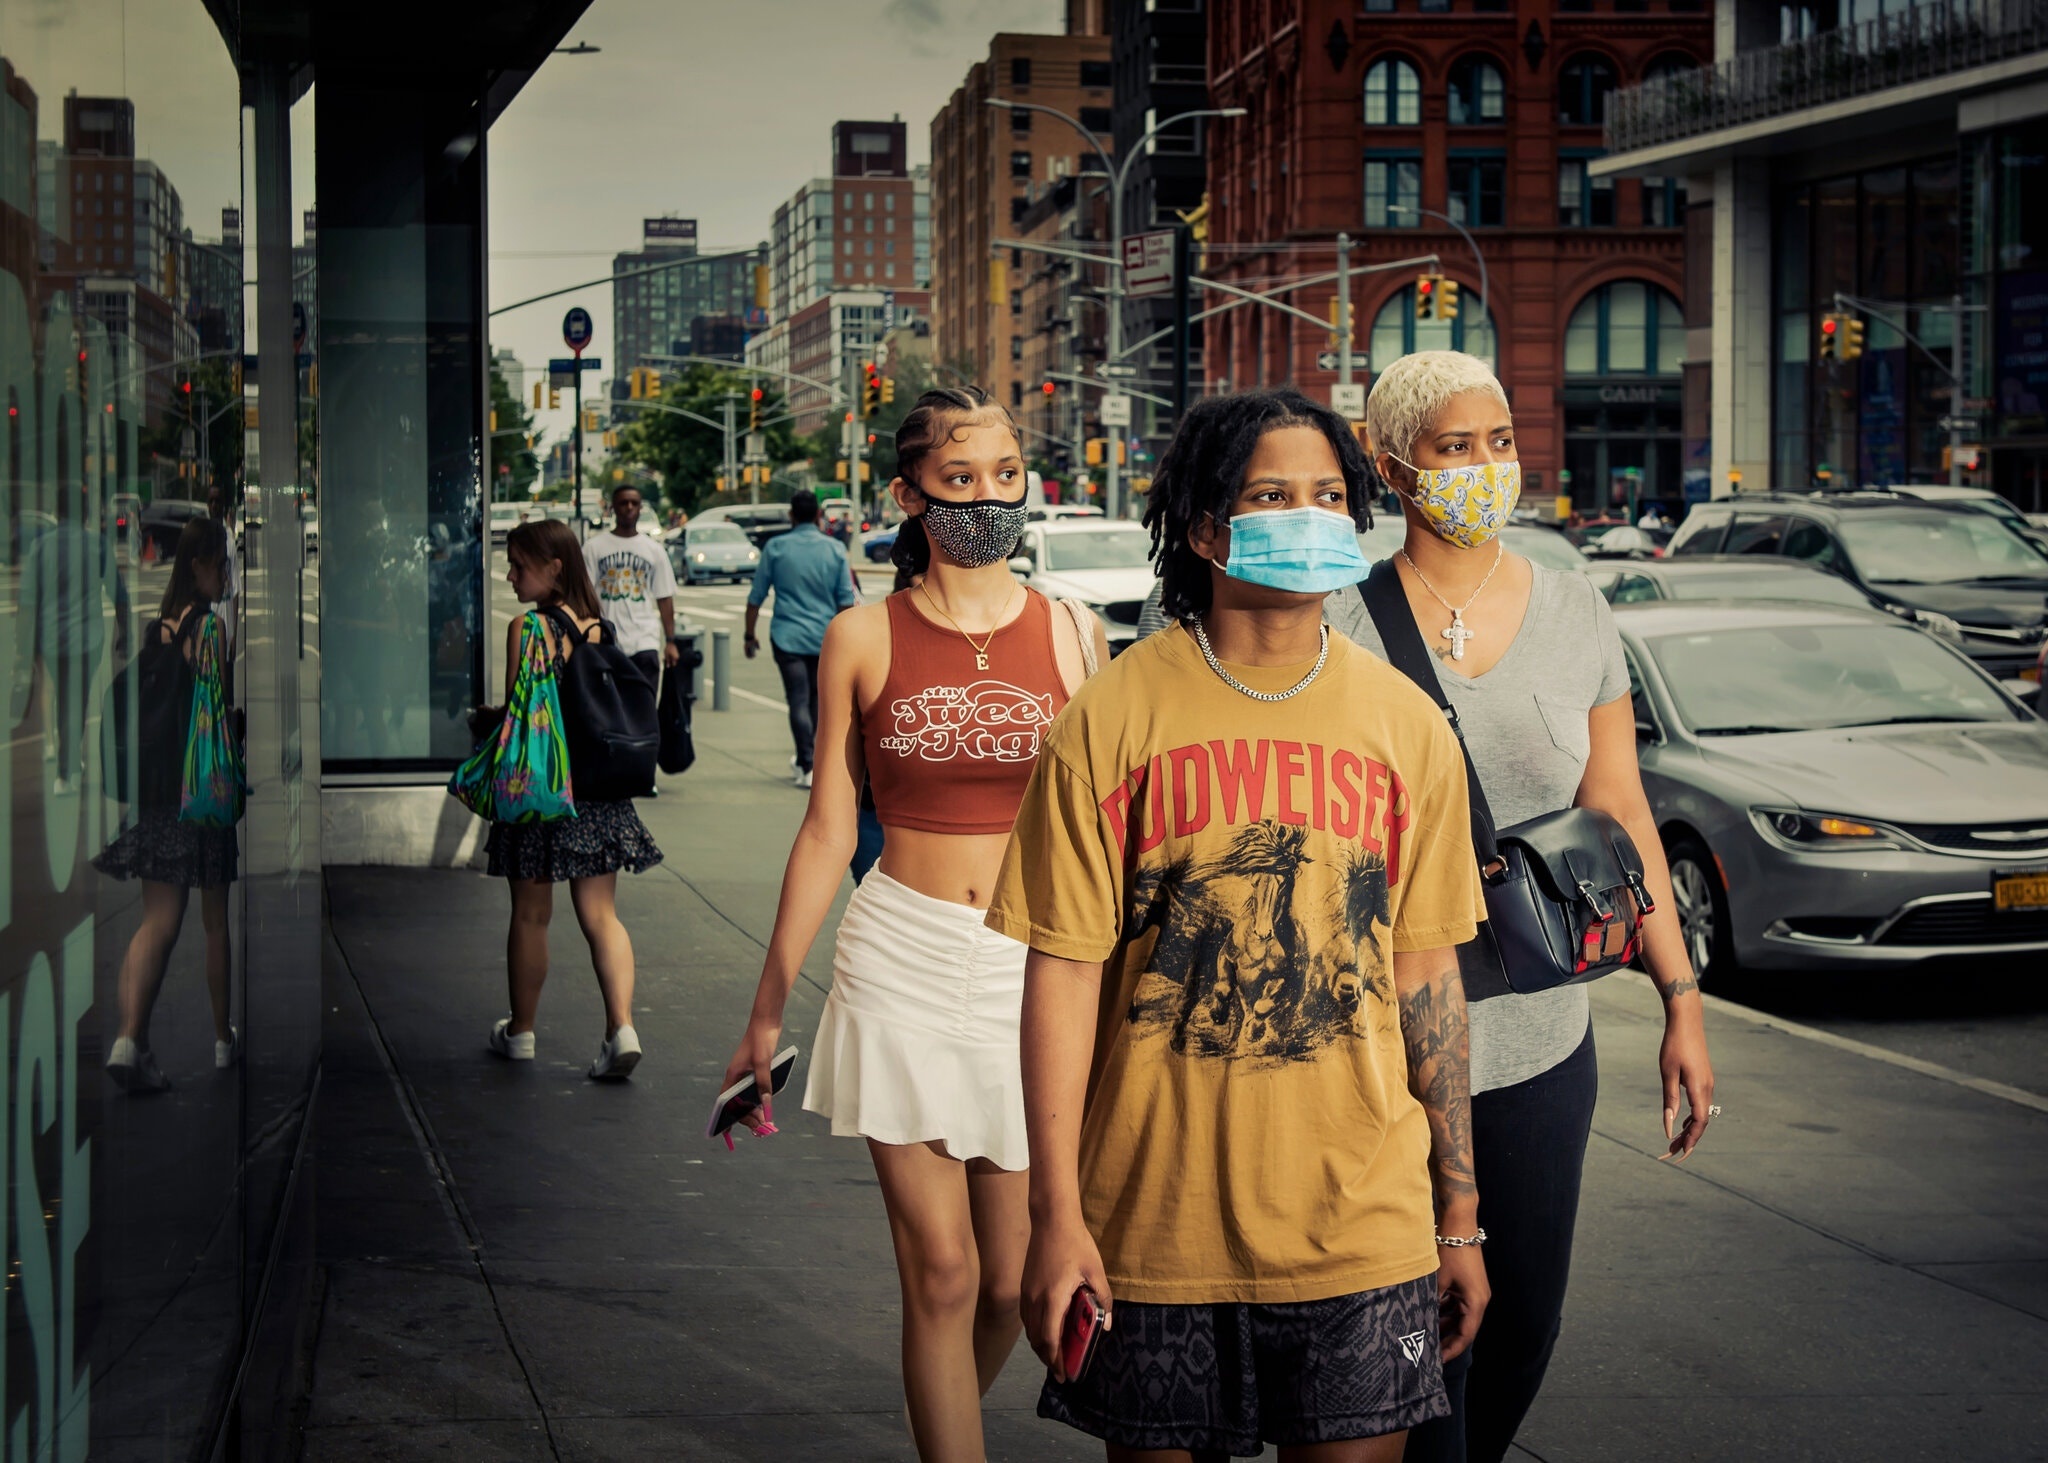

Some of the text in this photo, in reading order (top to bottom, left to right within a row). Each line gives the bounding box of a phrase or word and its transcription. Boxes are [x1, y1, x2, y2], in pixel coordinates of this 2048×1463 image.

[1599, 384, 1662, 403] CAMP
[975, 653, 990, 671] E
[923, 686, 965, 705] stay
[880, 736, 917, 757] stay
